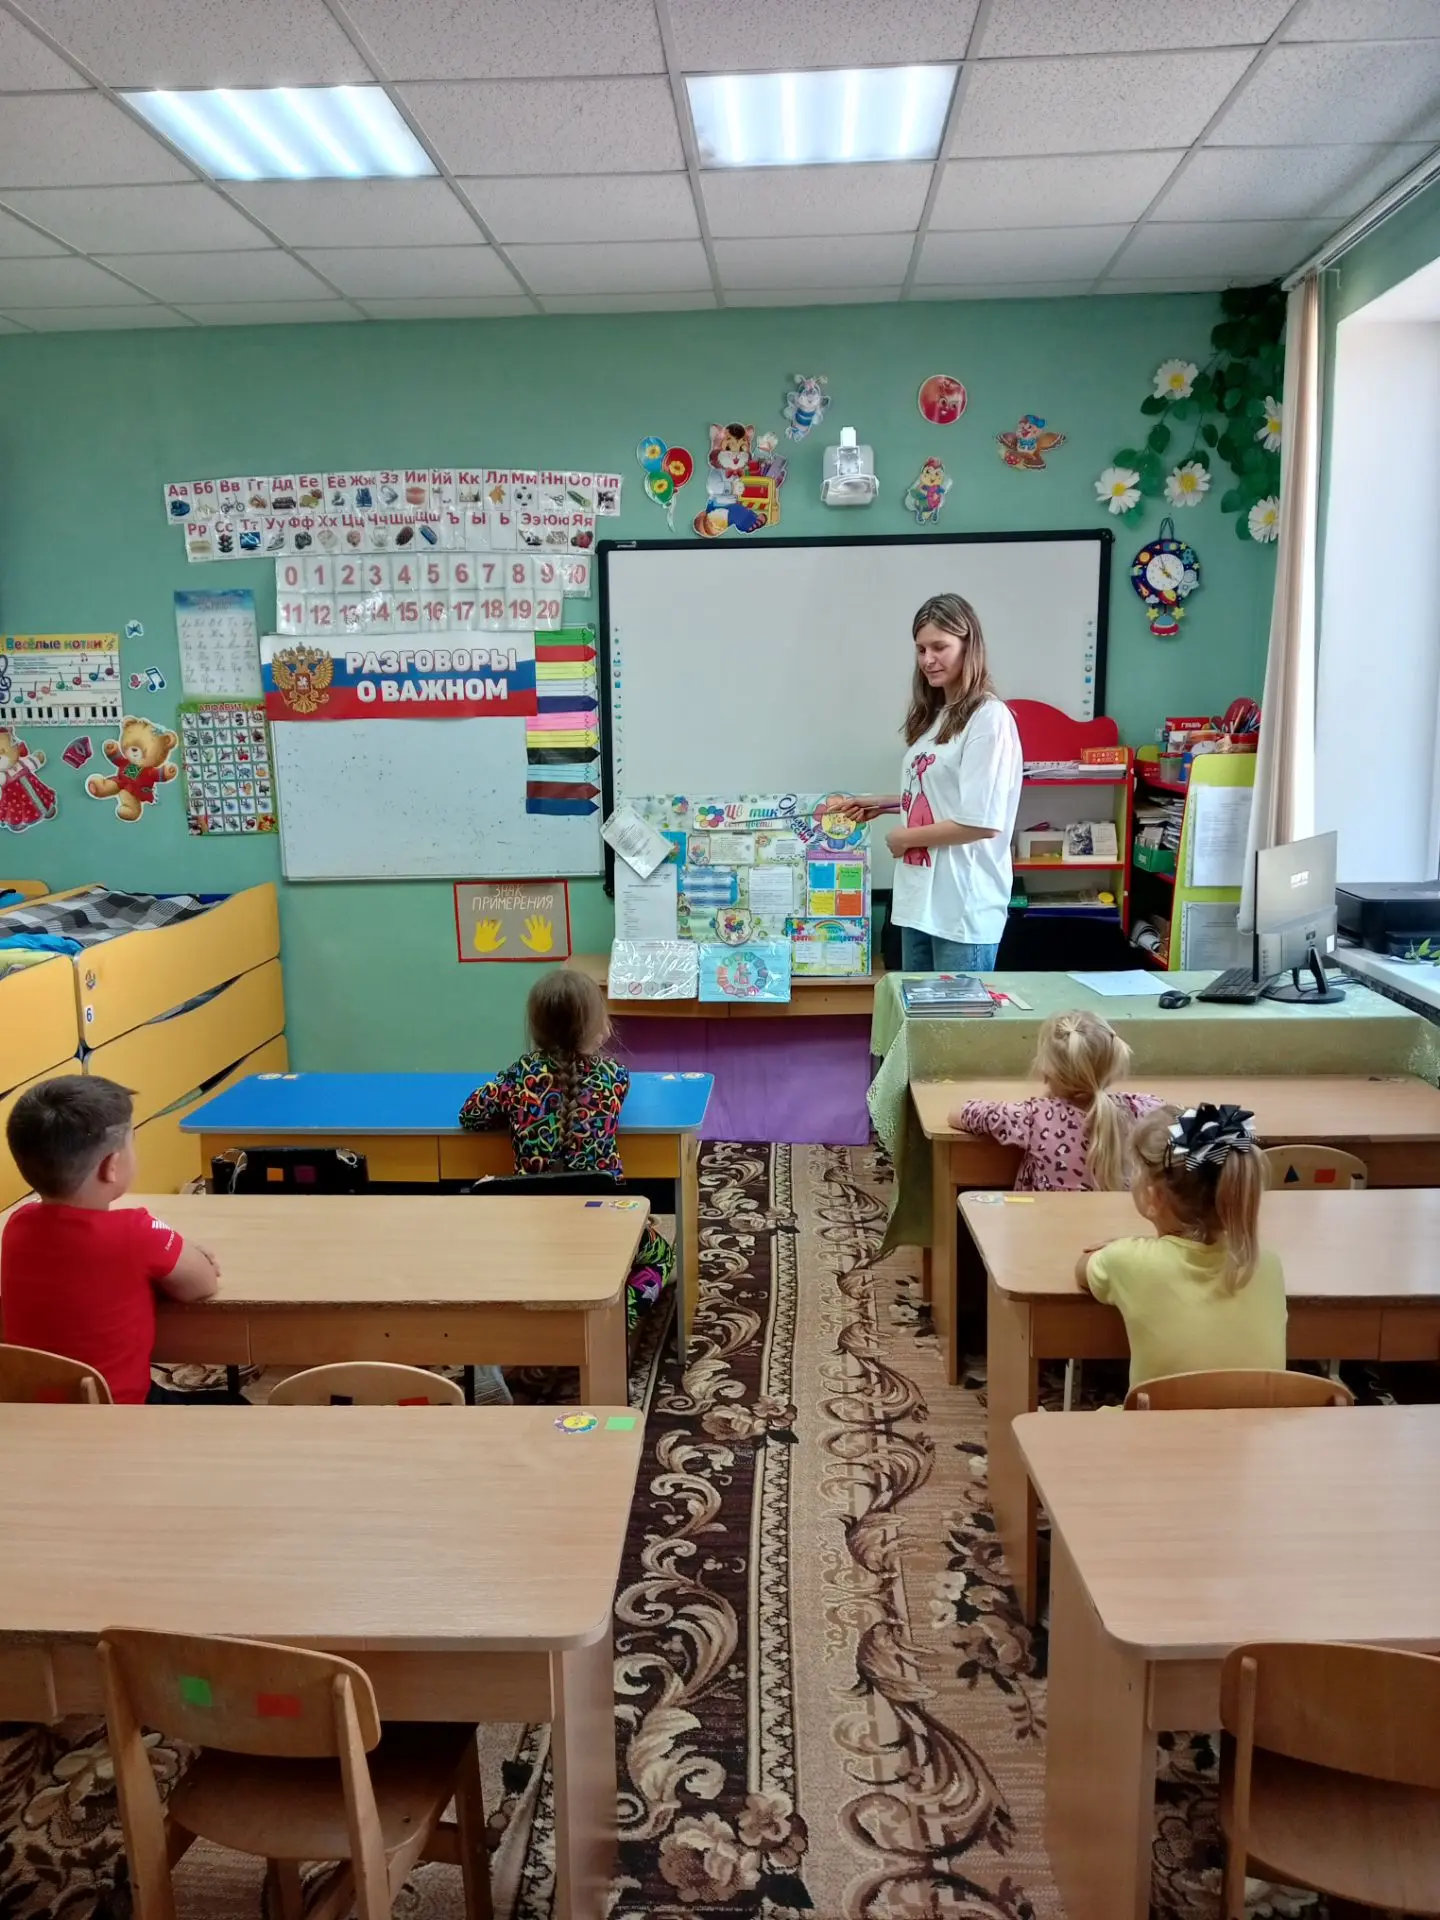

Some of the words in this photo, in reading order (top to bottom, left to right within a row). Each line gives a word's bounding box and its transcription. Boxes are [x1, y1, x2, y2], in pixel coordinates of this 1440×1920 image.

[168, 484, 188, 497] Аа
[193, 480, 214, 495] Бб
[220, 480, 240, 493] Вв
[248, 478, 264, 491] Гг
[300, 475, 319, 488] Ее
[327, 474, 346, 488] Ёё
[380, 472, 399, 484] Зз
[405, 471, 427, 482] Ии
[432, 472, 452, 485] Йй
[459, 472, 480, 484] Кк
[485, 471, 508, 484] Лл
[511, 472, 538, 485] Мм
[187, 523, 207, 537] Рр
[214, 521, 234, 533] Сс
[240, 519, 259, 531] Тт
[265, 517, 285, 531] Уу
[288, 516, 315, 531] Фф
[317, 514, 338, 527] Хх
[342, 513, 365, 529] Цц
[368, 513, 389, 526] Чч
[390, 513, 415, 525] Шш
[447, 512, 460, 524] Ъ
[472, 512, 486, 524] Ы
[500, 513, 510, 525] Ь
[522, 513, 541, 525] Ээ
[543, 514, 570, 526] Юю
[572, 513, 593, 526] Яя
[285, 565, 298, 586] 0
[314, 565, 324, 585] 1
[341, 564, 355, 585] 2
[369, 565, 382, 585] 3
[398, 564, 411, 584] 4
[427, 563, 440, 584] 5
[455, 563, 469, 583] 6
[482, 563, 495, 583] 7
[512, 563, 525, 584] 8
[540, 563, 554, 584] 9
[282, 603, 303, 624] 11
[310, 604, 331, 625] 12
[396, 601, 418, 622] 15
[423, 601, 445, 621] 16
[453, 601, 474, 621] 17
[481, 599, 504, 619] 18
[508, 599, 532, 619] 19
[536, 599, 560, 619] 20
[345, 648, 517, 674] РАЗГОВОРЫ
[357, 680, 377, 702] О
[381, 678, 508, 702] ВАЖНОМ
[494, 884, 524, 897] ЗНАК
[472, 895, 554, 911] ПРИМЕРЕНИЯ
[86, 1007, 92, 1022] 6
